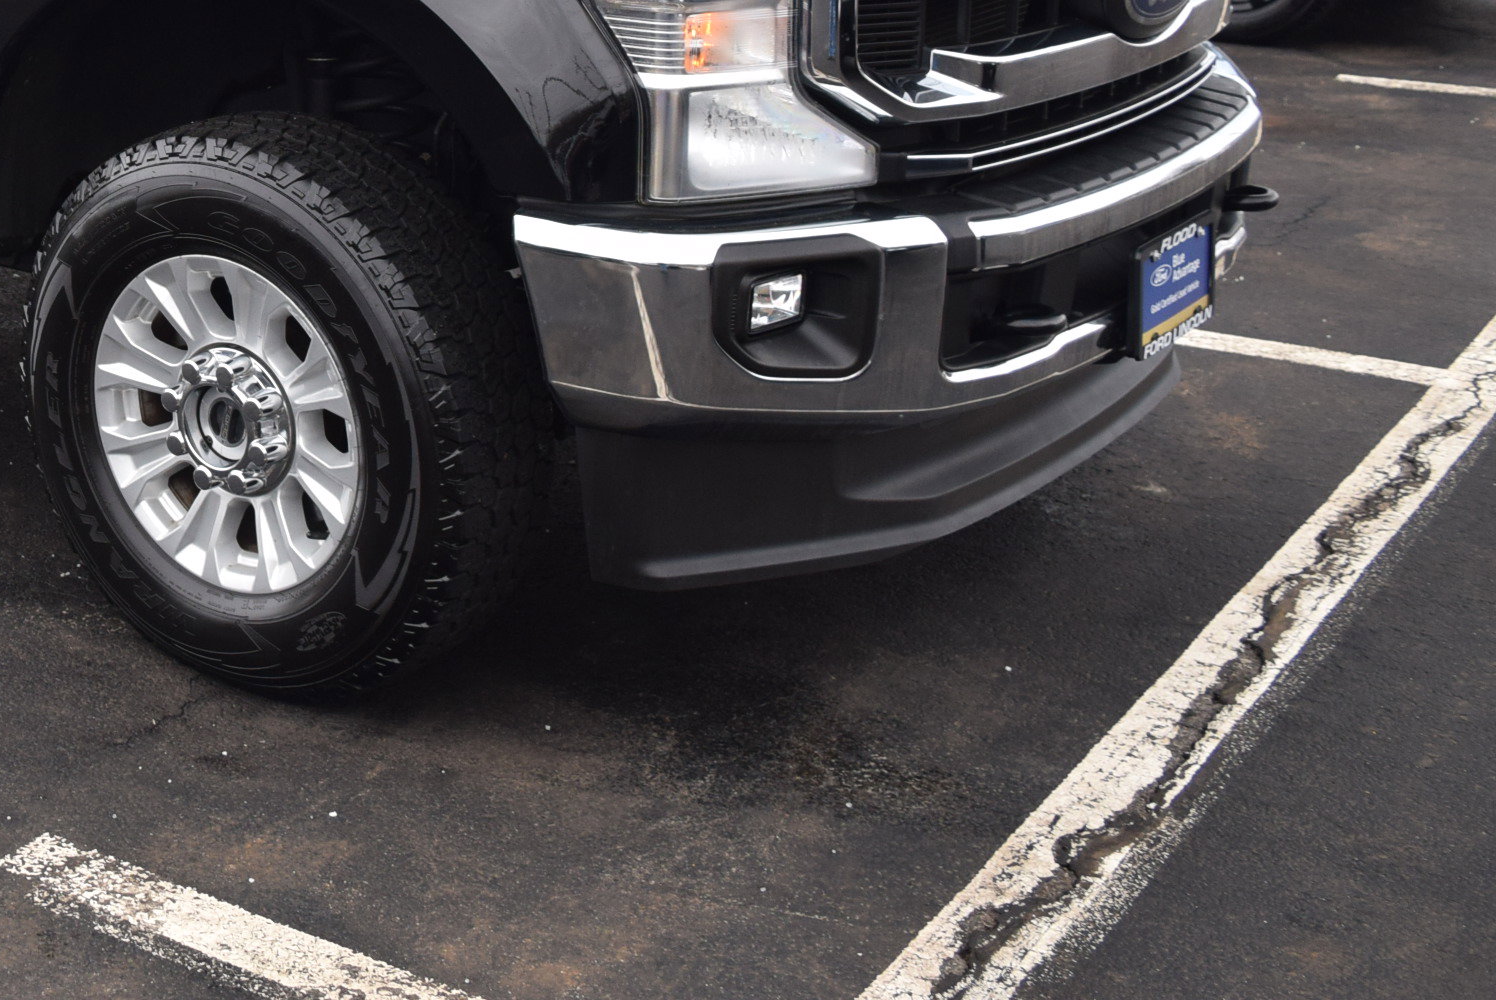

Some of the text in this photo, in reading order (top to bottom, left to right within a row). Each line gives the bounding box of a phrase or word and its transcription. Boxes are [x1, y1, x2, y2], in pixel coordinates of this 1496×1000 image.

[1160, 223, 1197, 254] FLOOD
[1143, 304, 1213, 360] FORD LINCOLN
[207, 210, 392, 525] GOODYEAR
